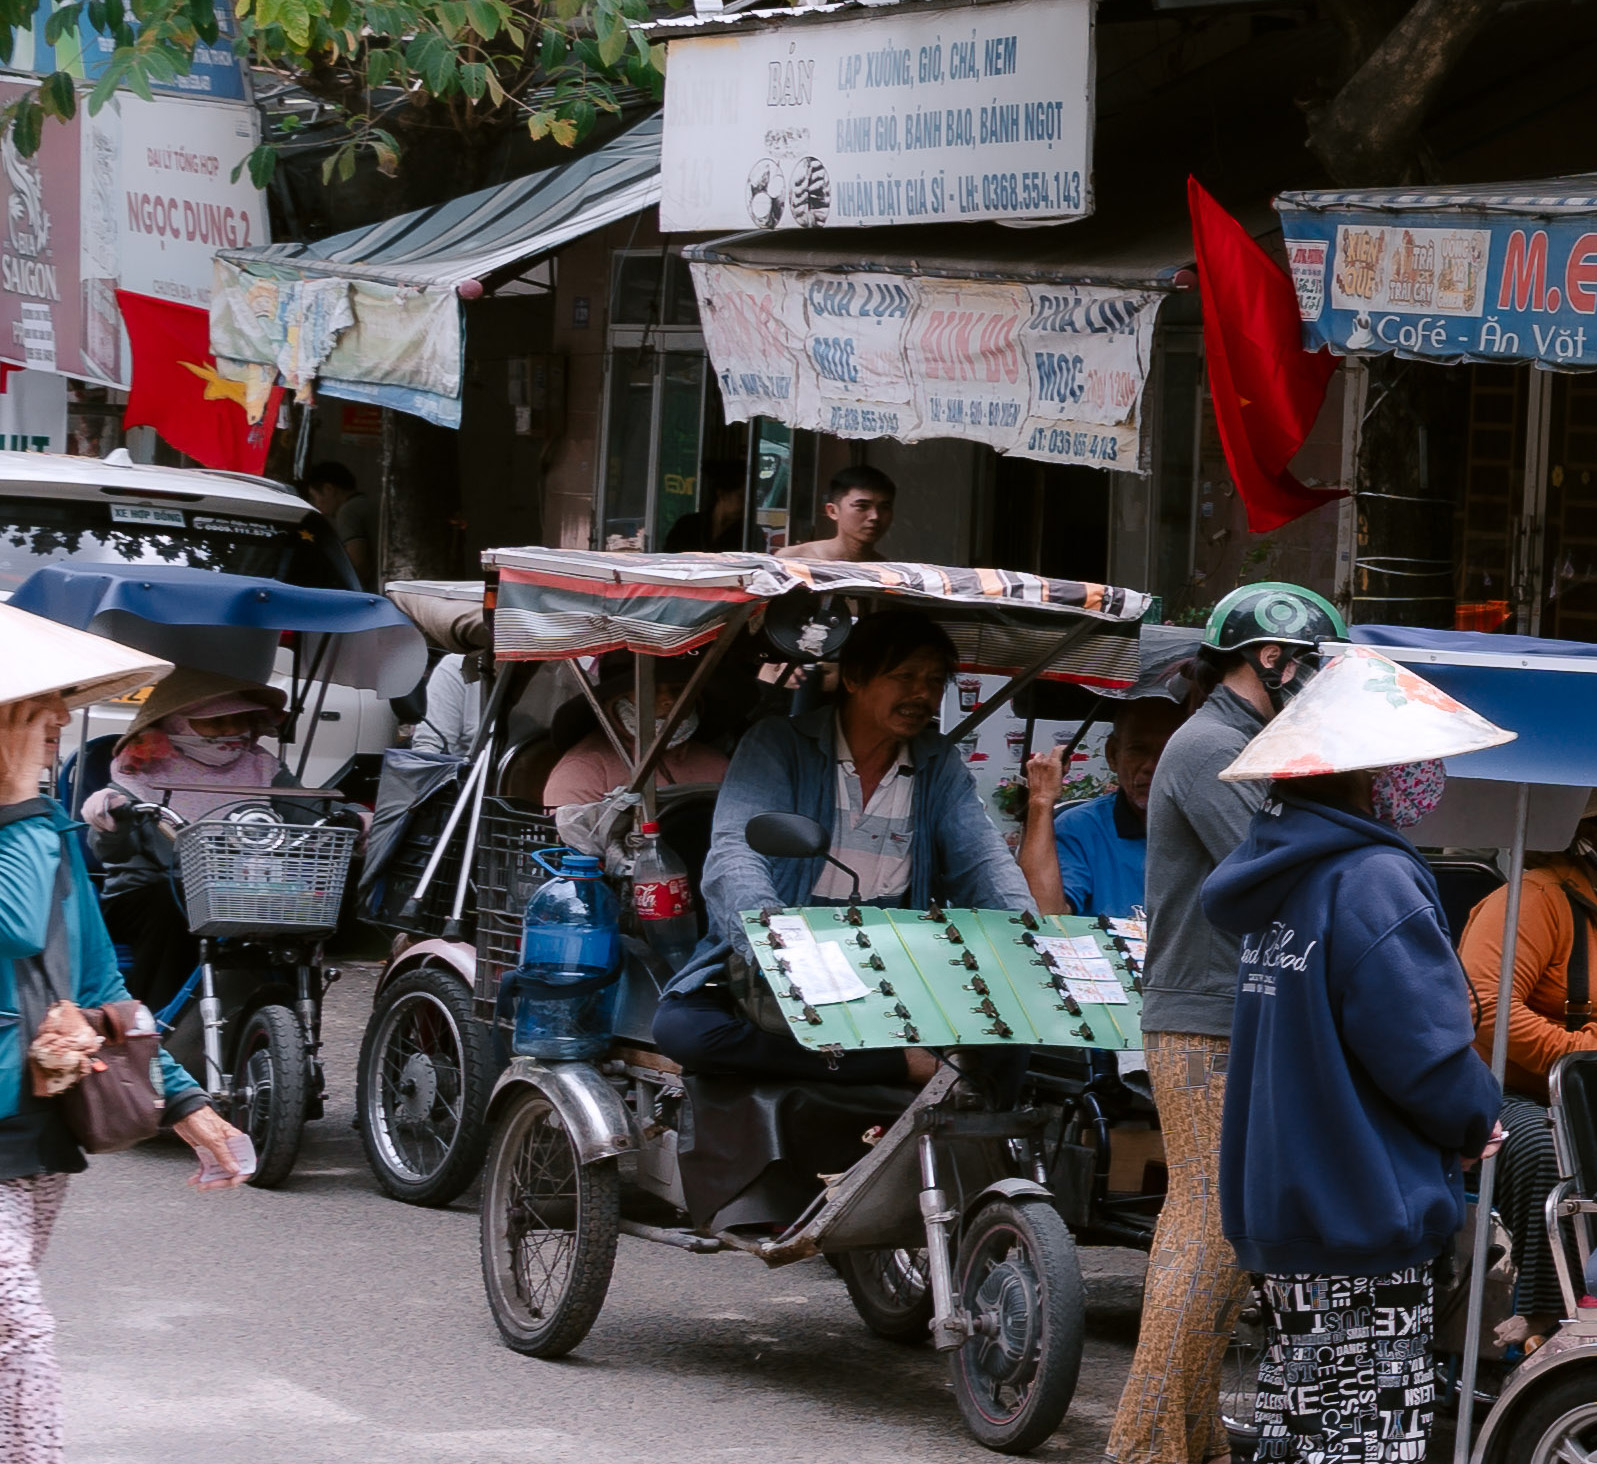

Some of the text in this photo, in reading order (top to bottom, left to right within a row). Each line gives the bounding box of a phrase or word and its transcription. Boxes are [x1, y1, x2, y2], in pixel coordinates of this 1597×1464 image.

[766, 41, 816, 107] BÁN
[838, 54, 862, 100] LẠP
[918, 35, 945, 85] GIÒ,
[949, 28, 980, 82] CHẢ,
[983, 35, 1018, 77] NEM
[836, 98, 1064, 155] BÁNH GIÒ, BÁNH BAO, BÁNH NGỌT
[126, 191, 253, 251] NGỌC DUNG 2
[836, 174, 874, 225] NHẬN
[876, 171, 901, 225] ĐẶT
[905, 169, 928, 215] GIÁ
[958, 176, 980, 214] LH:
[982, 170, 1081, 212] 0368.554.143
[1, 254, 61, 302] SAIGON
[1375, 315, 1447, 354] Café
[1479, 315, 1521, 354] Ăn
[1533, 322, 1589, 364] Vặt
